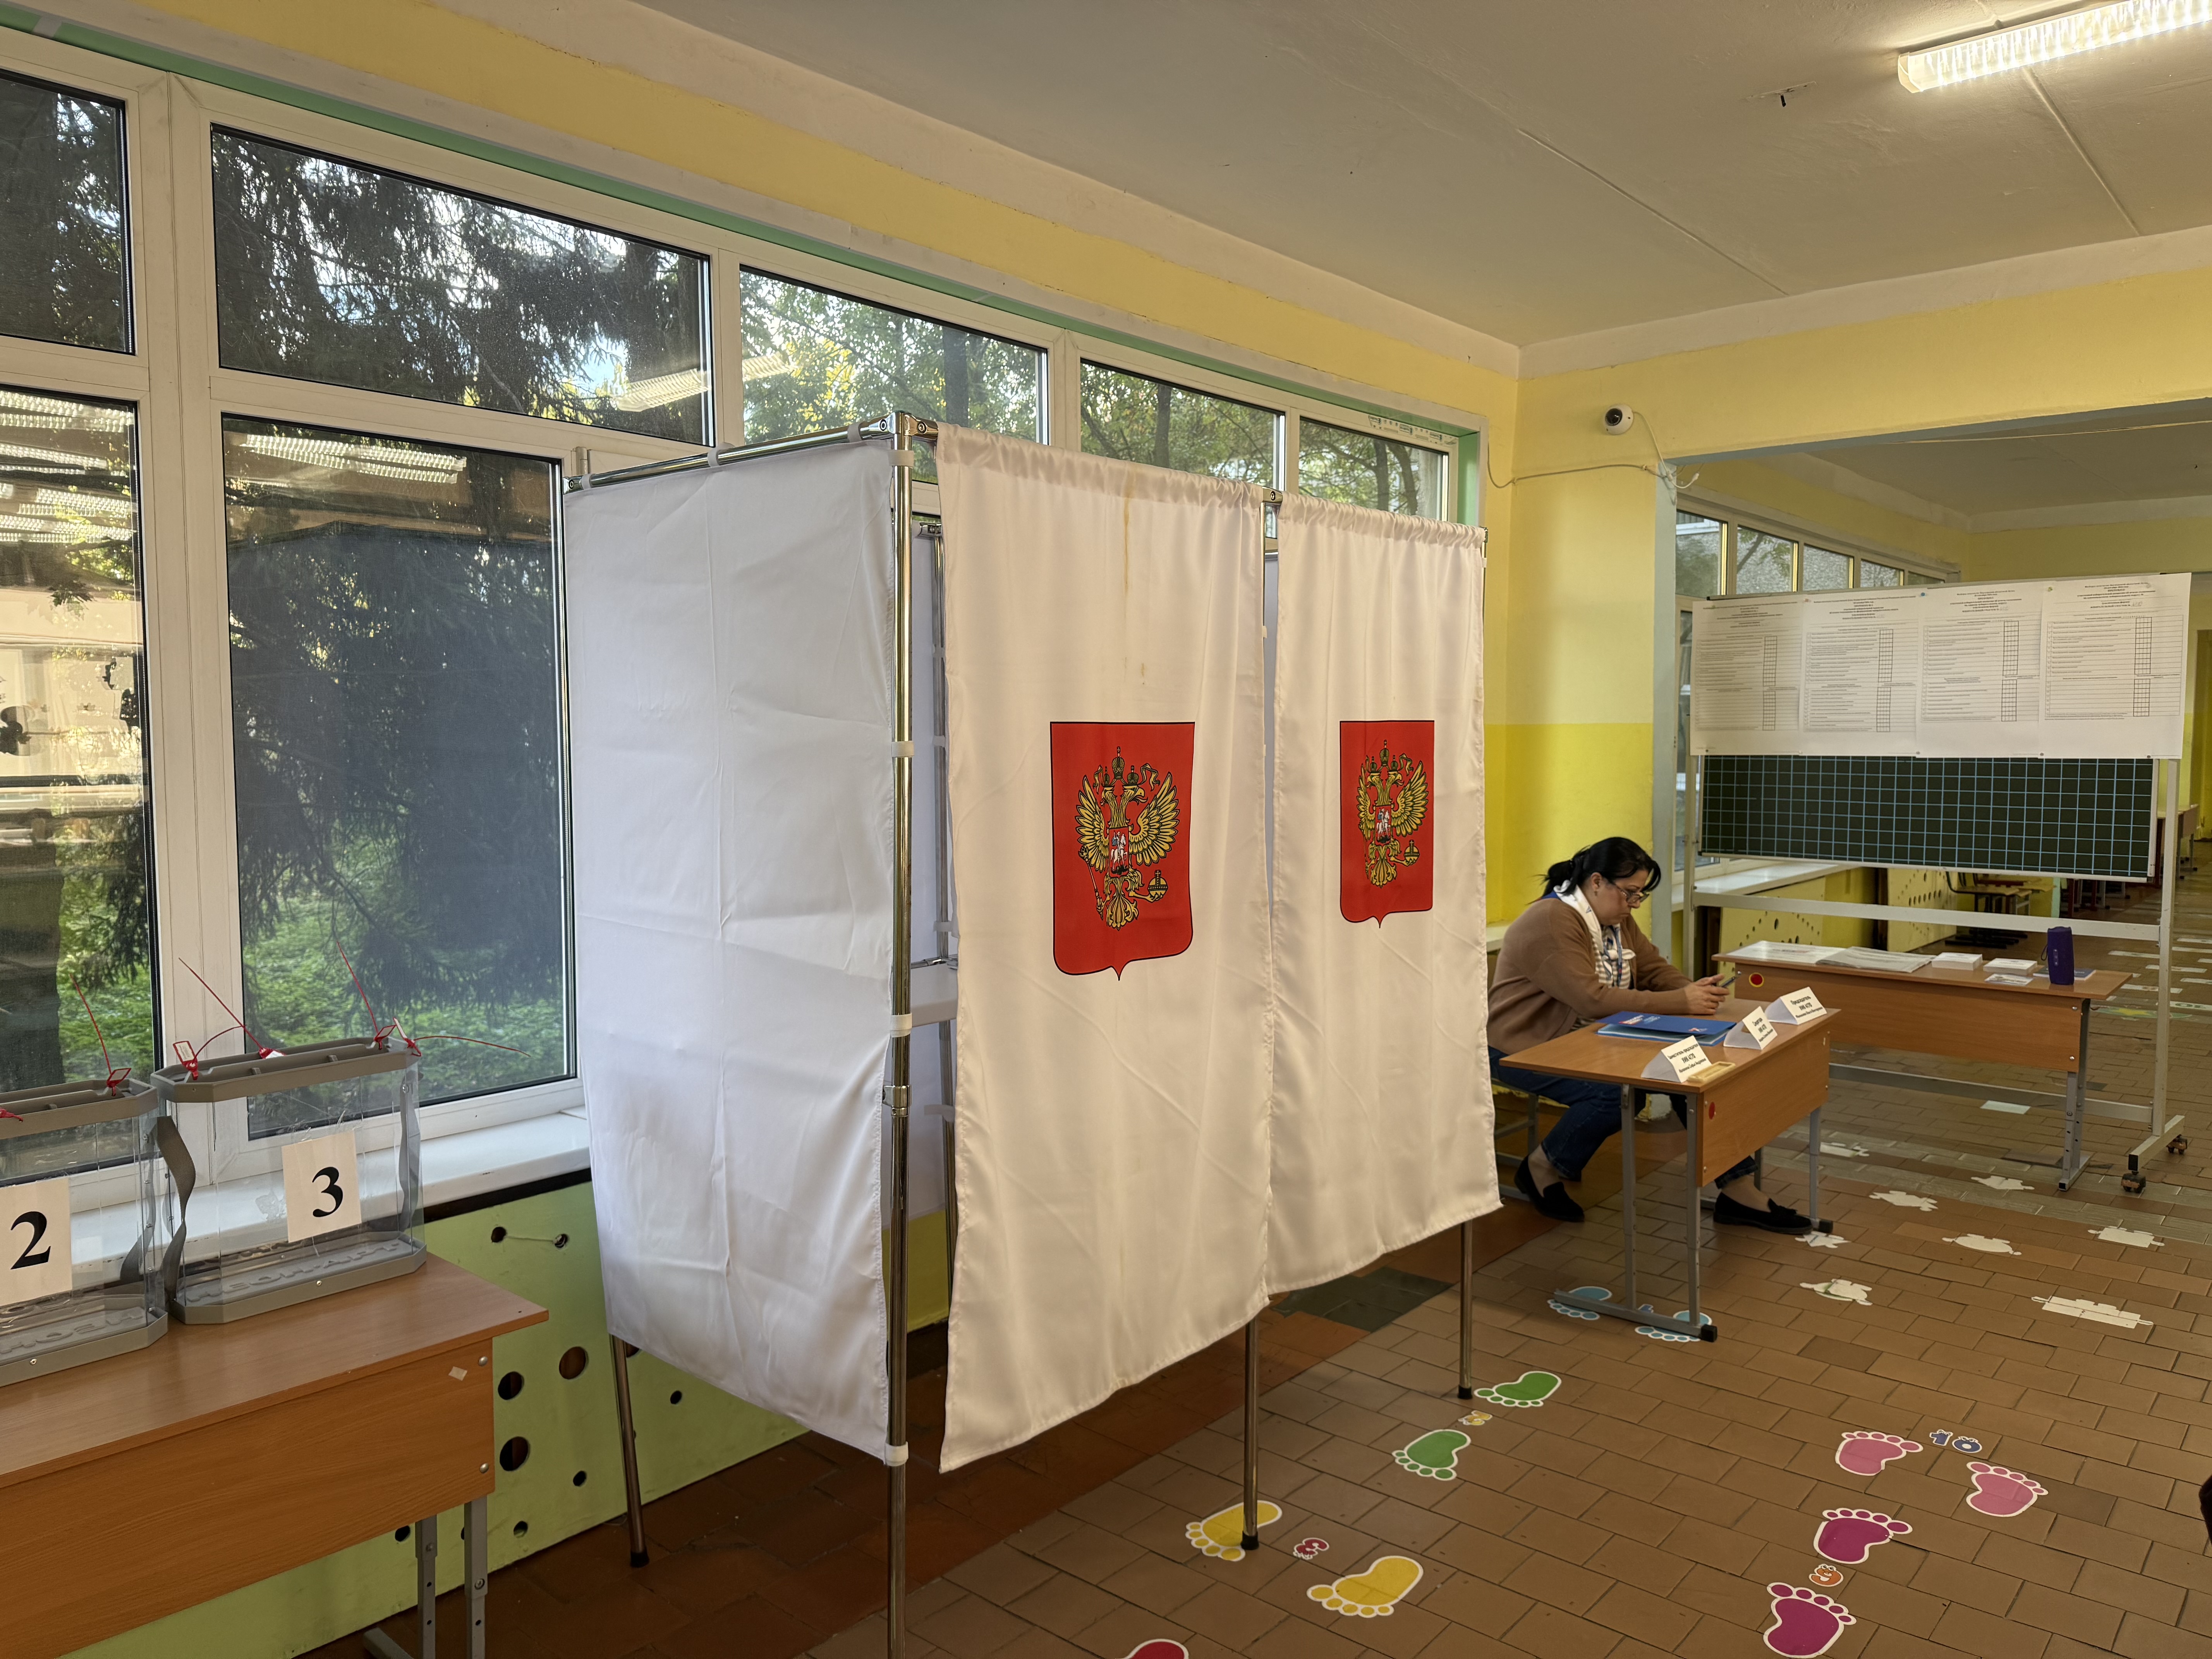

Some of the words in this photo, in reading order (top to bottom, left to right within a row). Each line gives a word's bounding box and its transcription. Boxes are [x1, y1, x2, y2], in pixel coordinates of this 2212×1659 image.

[312, 1166, 343, 1218] 3
[10, 1211, 51, 1270] 2
[1929, 1429, 1982, 1453] 10
[1293, 1537, 1329, 1560] 3
[1809, 1564, 1844, 1587] 9
